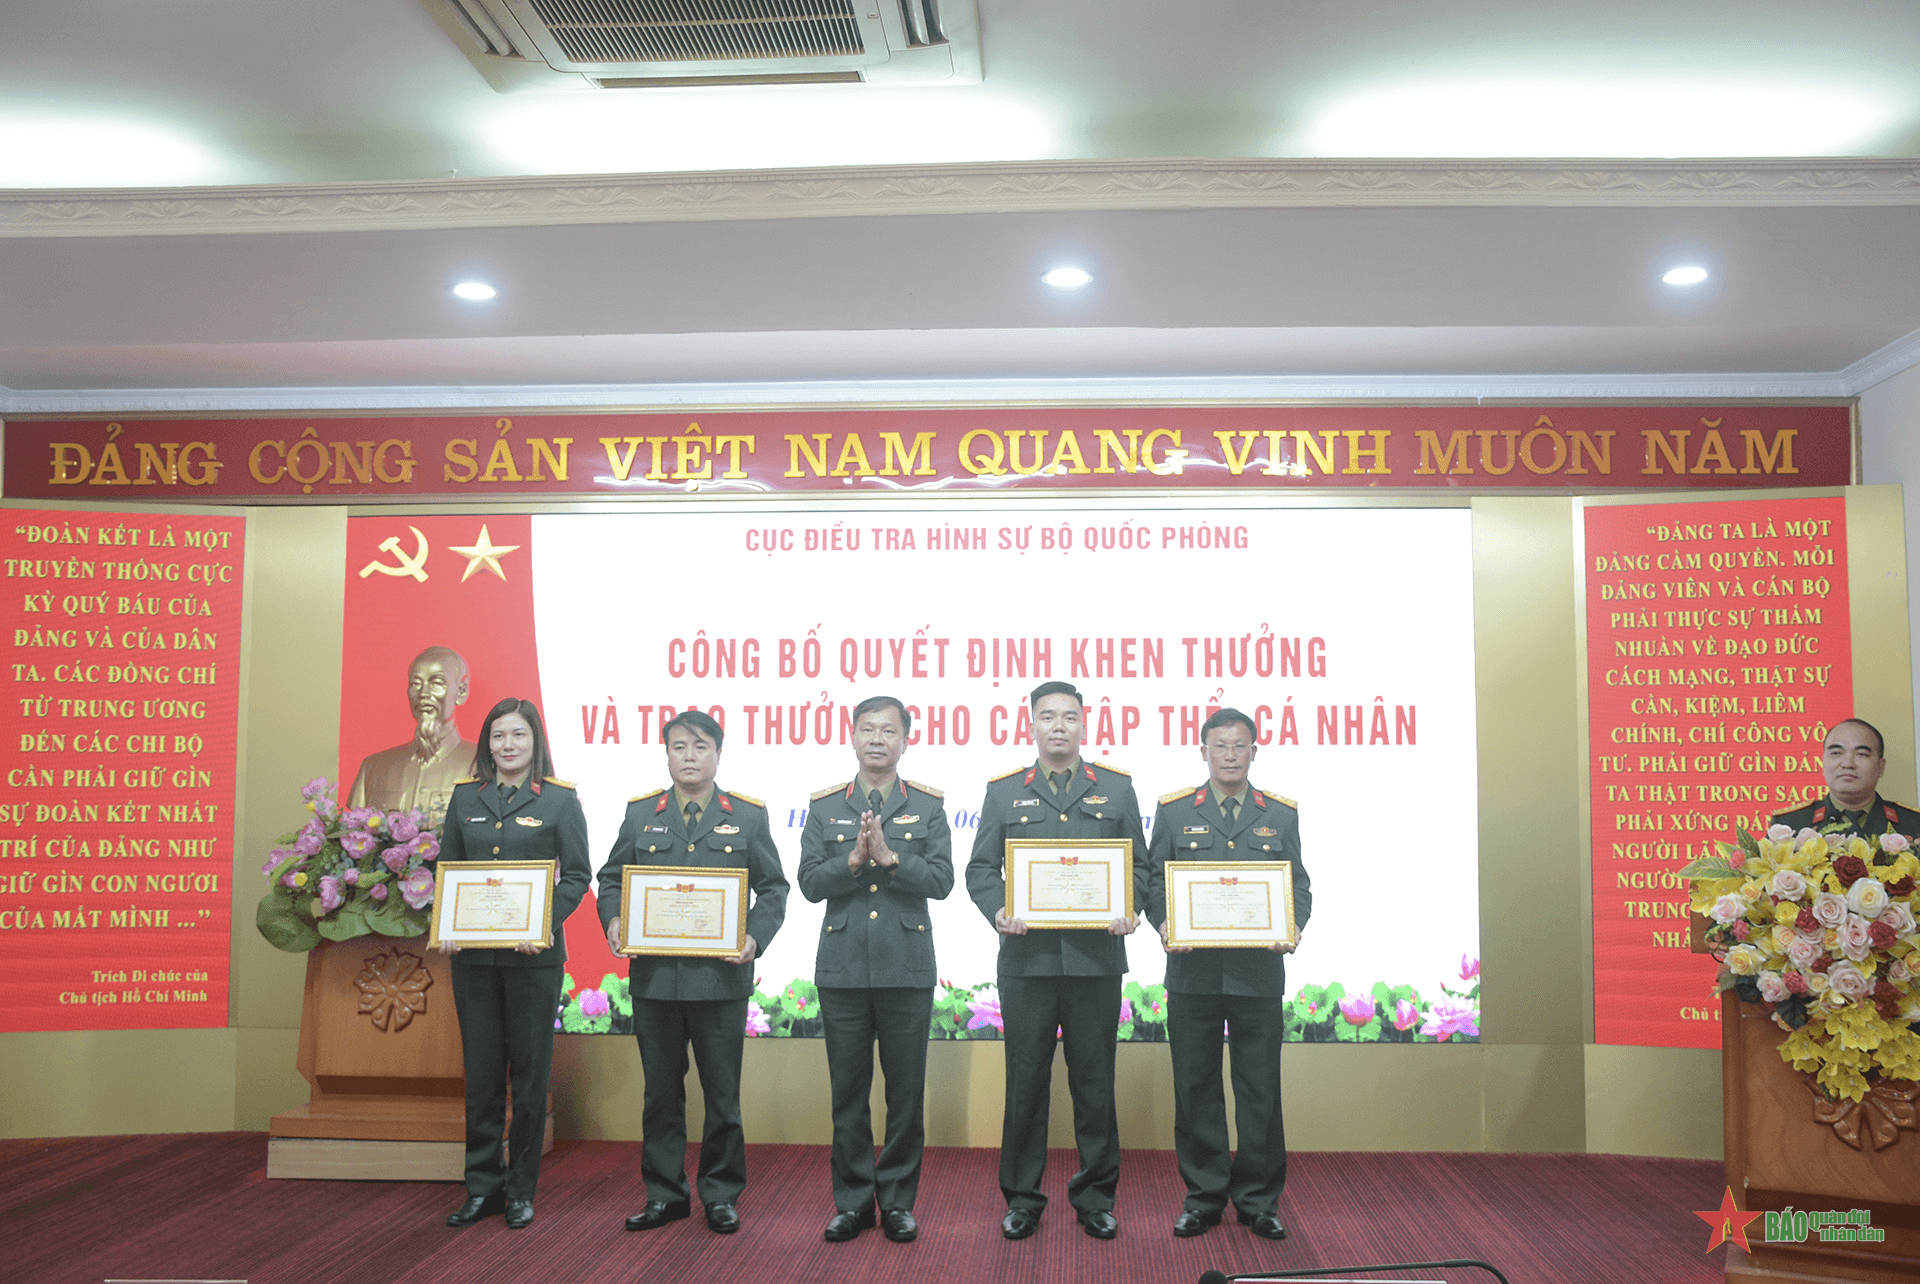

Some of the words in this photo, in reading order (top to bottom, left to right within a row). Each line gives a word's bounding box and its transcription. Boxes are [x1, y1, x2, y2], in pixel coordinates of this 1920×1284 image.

[49, 423, 224, 486] ĐẢNG
[249, 426, 418, 494] CỘNG
[444, 418, 573, 483] SẢN
[599, 422, 755, 491] VIỆT
[784, 432, 937, 477] NAM
[958, 428, 1189, 477] QUANG
[1213, 430, 1392, 476] VINH
[1414, 415, 1617, 475] MUÔN
[1640, 417, 1799, 475] NĂM
[98, 523, 141, 546] KẾT
[148, 525, 176, 547] LÀ
[184, 529, 233, 552] MỘT
[746, 528, 794, 557] CỤC
[804, 521, 860, 551] ĐIỀU
[871, 528, 916, 550] TRA
[927, 523, 987, 550] HÌNH
[998, 525, 1033, 555] SỰ
[1041, 522, 1073, 555] BỘ
[1084, 518, 1151, 552] QUỐC
[1162, 520, 1248, 549] PHÒNG
[1720, 523, 1745, 539] TA
[1751, 518, 1778, 539] LÀ
[1785, 518, 1831, 540] MỘT
[5, 556, 95, 578] TRUYỀN
[102, 558, 180, 581] THỐNG
[187, 562, 233, 586] CỰC
[1596, 551, 1650, 572] ĐẢNG
[1657, 549, 1701, 570] CẦM
[1709, 547, 1786, 571] QUYỀN.
[1601, 579, 1656, 600] ĐẢNG
[1663, 577, 1711, 599] VIÊN
[1718, 576, 1745, 597] VÀ
[1752, 575, 1794, 596] CÁN
[1802, 576, 1830, 598] BỘ
[24, 590, 56, 612] KỲ
[62, 591, 110, 617] QUÝ
[117, 592, 161, 614] BÁU
[168, 594, 213, 616] CỦA
[1611, 608, 1658, 628] PHẢI
[1664, 608, 1721, 630] THỰC
[1728, 607, 1755, 629] SỰ
[14, 624, 77, 648] ĐẢNG
[85, 625, 114, 648] VÀ
[122, 626, 166, 649] CỦA
[173, 627, 217, 650] DÂN
[1615, 636, 1685, 656] NHUẦN
[1692, 635, 1718, 655] VỀ
[1725, 638, 1768, 659] ĐẠO
[1775, 633, 1819, 654] ĐỨC
[668, 629, 760, 678] CÔNG
[779, 623, 822, 678] BỐ
[840, 624, 949, 683] QUYẾT
[967, 638, 1051, 687] ĐỊNH
[1071, 638, 1163, 678] KHEN
[1182, 622, 1326, 678] THƯỞNG
[12, 664, 46, 682] TA.
[54, 660, 100, 682] CÁC
[107, 661, 170, 684] ĐỒNG
[177, 662, 217, 685] CHÍ
[1606, 665, 1661, 686] CÁCH
[1669, 668, 1736, 688] MẠNG,
[1741, 665, 1797, 687] THẬT
[1804, 664, 1832, 687] SỰ
[58, 699, 135, 718] TRUNG
[143, 698, 206, 719] ƯƠNG
[1631, 694, 1679, 717] CẦN,
[1686, 696, 1746, 717] KIỆM,
[1753, 692, 1805, 714] LIÊM
[582, 696, 620, 744] VÀ
[743, 691, 854, 745] THƯỞN
[905, 705, 970, 746] CHO
[990, 696, 1033, 746] CÁ
[1081, 696, 1140, 755] TẬP
[1254, 696, 1299, 746] CÁ
[1317, 696, 1416, 746] NHÂN
[1611, 723, 1683, 746] CHÍNH,
[1689, 722, 1726, 743] CHÍ
[1733, 722, 1792, 743] CÔNG
[1799, 721, 1828, 743] VÔ
[20, 729, 66, 752] ĐẾN
[73, 730, 119, 752] CÁC
[126, 734, 166, 753] CHI
[174, 733, 203, 758] BỘ
[1599, 754, 1632, 773] TƯ.
[1639, 752, 1687, 773] PHẢI
[1694, 753, 1733, 773] GIỮ
[1739, 751, 1777, 773] GÌN
[8, 764, 54, 787] CẦN
[62, 765, 116, 787] PHẢI
[123, 765, 167, 788] GIỮ
[172, 765, 212, 788] GÌN
[1606, 785, 1630, 802] TA
[1636, 783, 1690, 806] THẬT
[1696, 785, 1768, 802] TRONG
[0, 802, 30, 827] SỰ
[35, 799, 98, 823] ĐOÀN
[106, 800, 151, 823] KẾT
[157, 800, 218, 823] NHẤT
[954, 809, 981, 829] 06
[1616, 810, 1664, 831] PHẢI
[1670, 810, 1729, 832] XỨNG
[0, 835, 38, 858] TRÍ
[45, 835, 91, 858] CỦA
[98, 835, 160, 858] ĐẢNG
[168, 837, 217, 858] NHƯ
[1612, 839, 1679, 860] NGƯỜI
[42, 869, 84, 893] GÌN
[91, 875, 138, 893] CON
[145, 872, 218, 893] NGƯƠI
[1617, 868, 1684, 889] NGƯỜI
[0, 905, 46, 930] CỦA
[109, 905, 169, 928] MÌNH
[92, 970, 127, 983] Trích
[132, 970, 147, 982] Di
[151, 969, 182, 982] chúc
[185, 968, 208, 981] của
[59, 991, 87, 1004] Chủ
[92, 991, 117, 1006] tịch
[122, 988, 141, 1003] Hồ
[145, 990, 169, 1003] Chí
[174, 990, 207, 1002] Minh
[1680, 1006, 1709, 1020] Chủ
